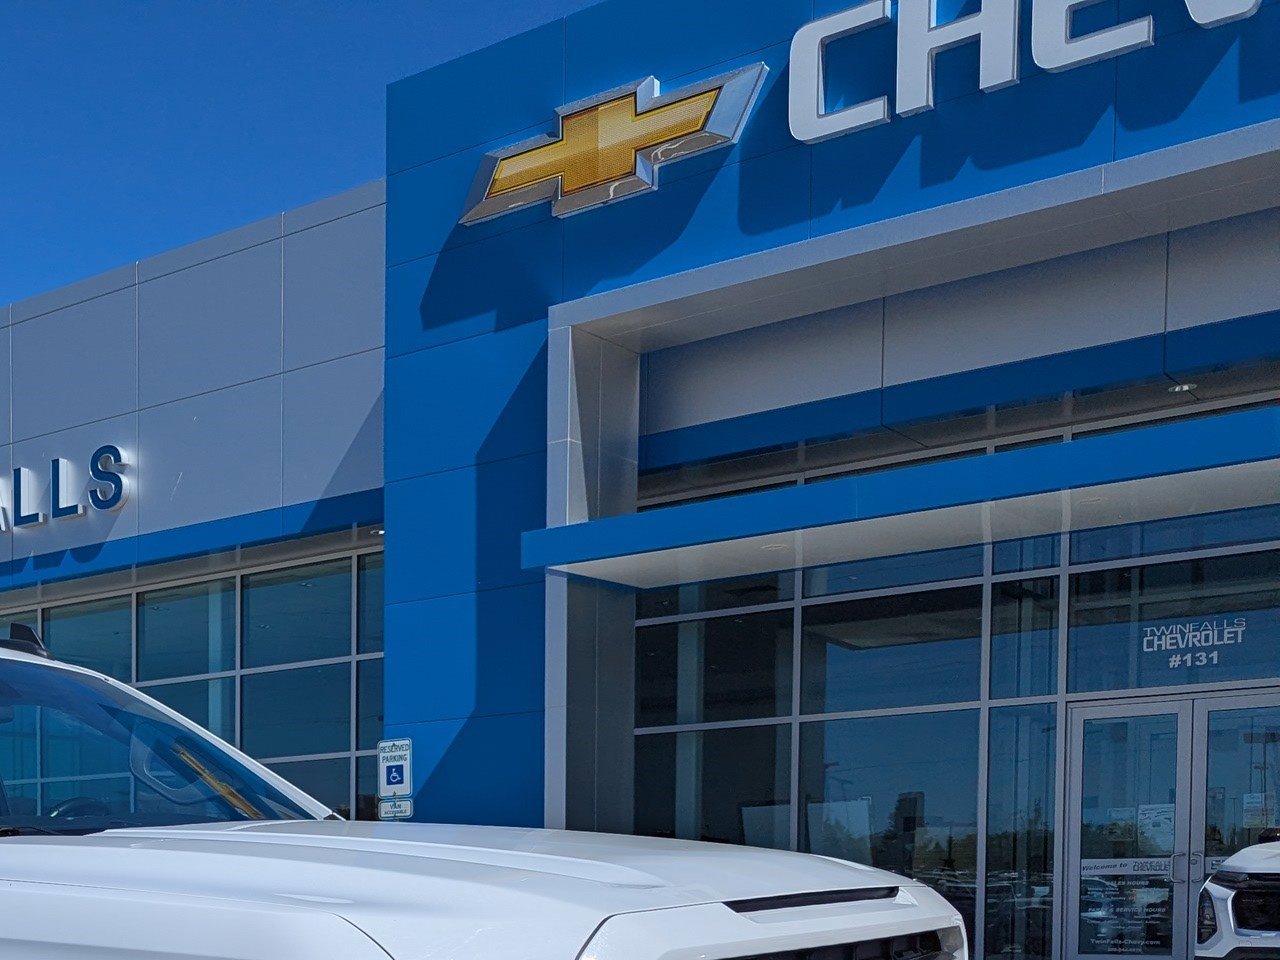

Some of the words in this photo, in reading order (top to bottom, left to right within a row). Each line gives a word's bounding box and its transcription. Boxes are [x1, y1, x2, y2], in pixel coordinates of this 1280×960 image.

[789, 0, 1262, 144] CHE
[1143, 627, 1246, 652] CHEVROLET
[1169, 651, 1218, 668] #131
[380, 743, 409, 753] RESERVED
[382, 754, 407, 763] PARKING
[1082, 863, 1117, 871] Welcome
